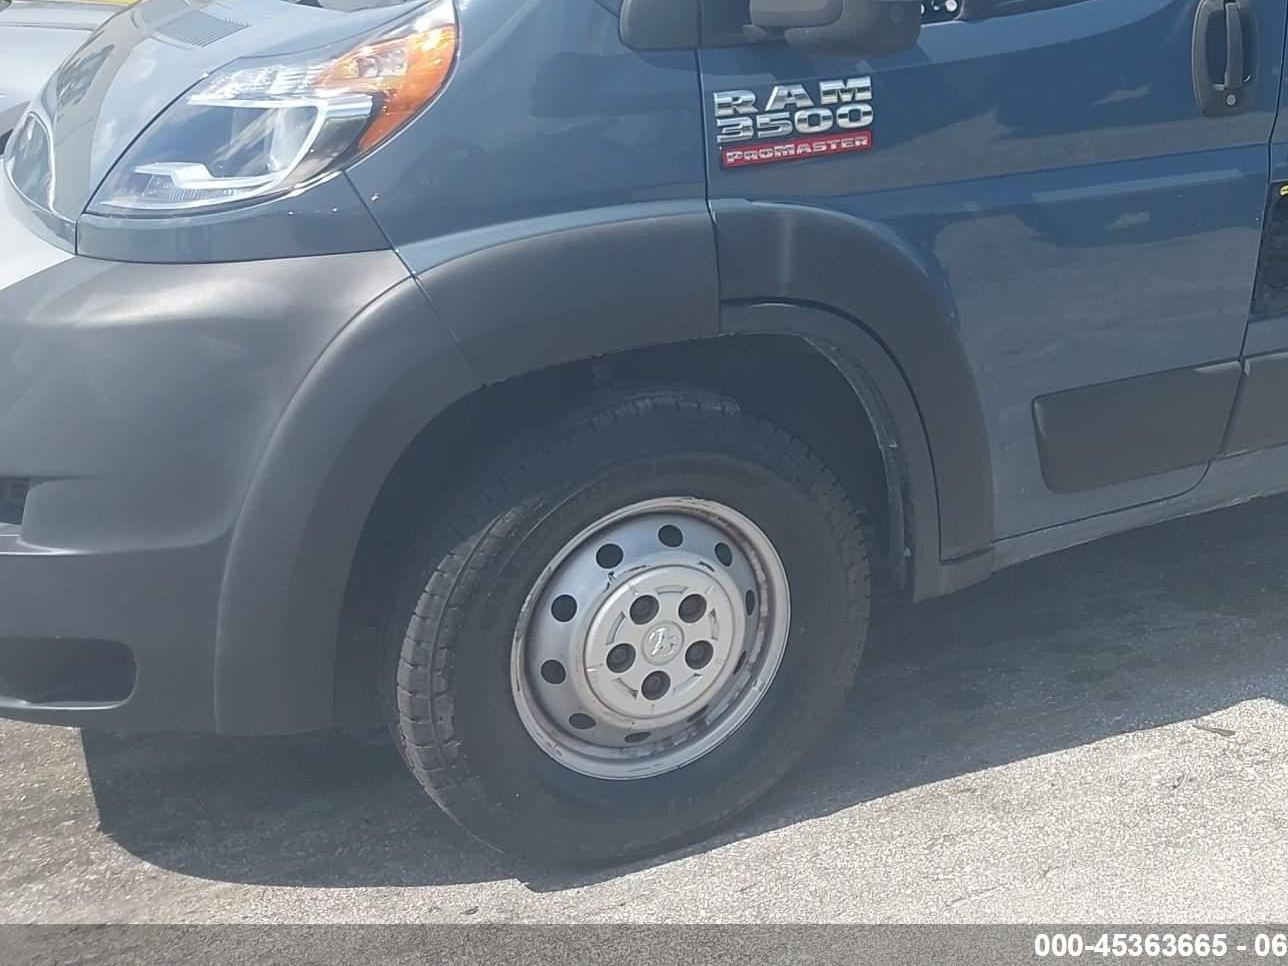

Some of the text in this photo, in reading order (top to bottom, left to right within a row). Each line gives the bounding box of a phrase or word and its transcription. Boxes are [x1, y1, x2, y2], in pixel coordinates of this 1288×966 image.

[713, 76, 873, 117] RAM
[716, 103, 874, 143] 3500
[725, 137, 869, 163] PROMASTER
